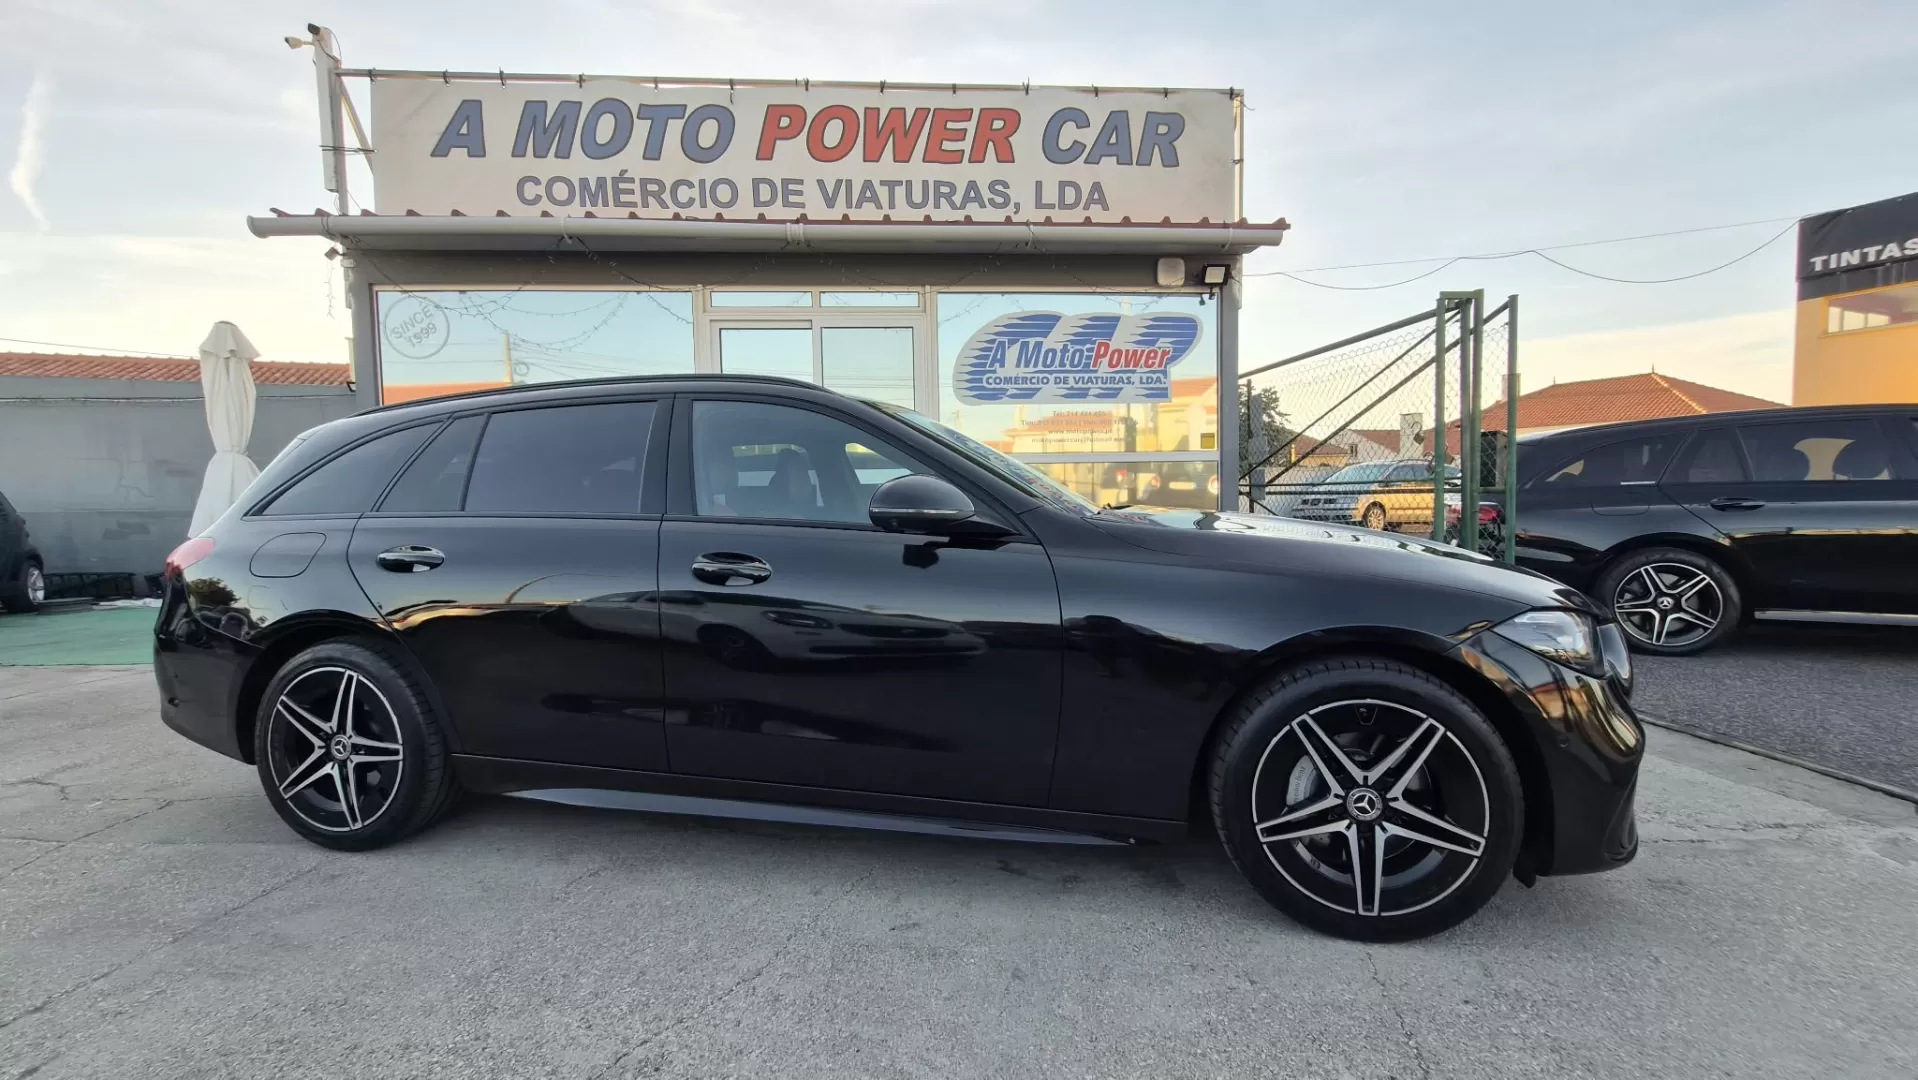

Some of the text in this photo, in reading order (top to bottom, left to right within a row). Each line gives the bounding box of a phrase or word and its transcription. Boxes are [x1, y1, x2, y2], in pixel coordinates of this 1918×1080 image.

[430, 97, 1186, 168] A MOTO POWER CAR
[516, 169, 1110, 214] COMÉRCIO DE VIATURAS, LDA
[1809, 238, 1918, 272] TINTAS
[391, 304, 433, 339] SINCE
[404, 322, 437, 348] 1999
[986, 339, 1172, 370] A Moto Power
[985, 373, 1051, 386] COMÉRCIO
[1054, 375, 1070, 386] DE
[1072, 375, 1135, 387] VIATURAS,
